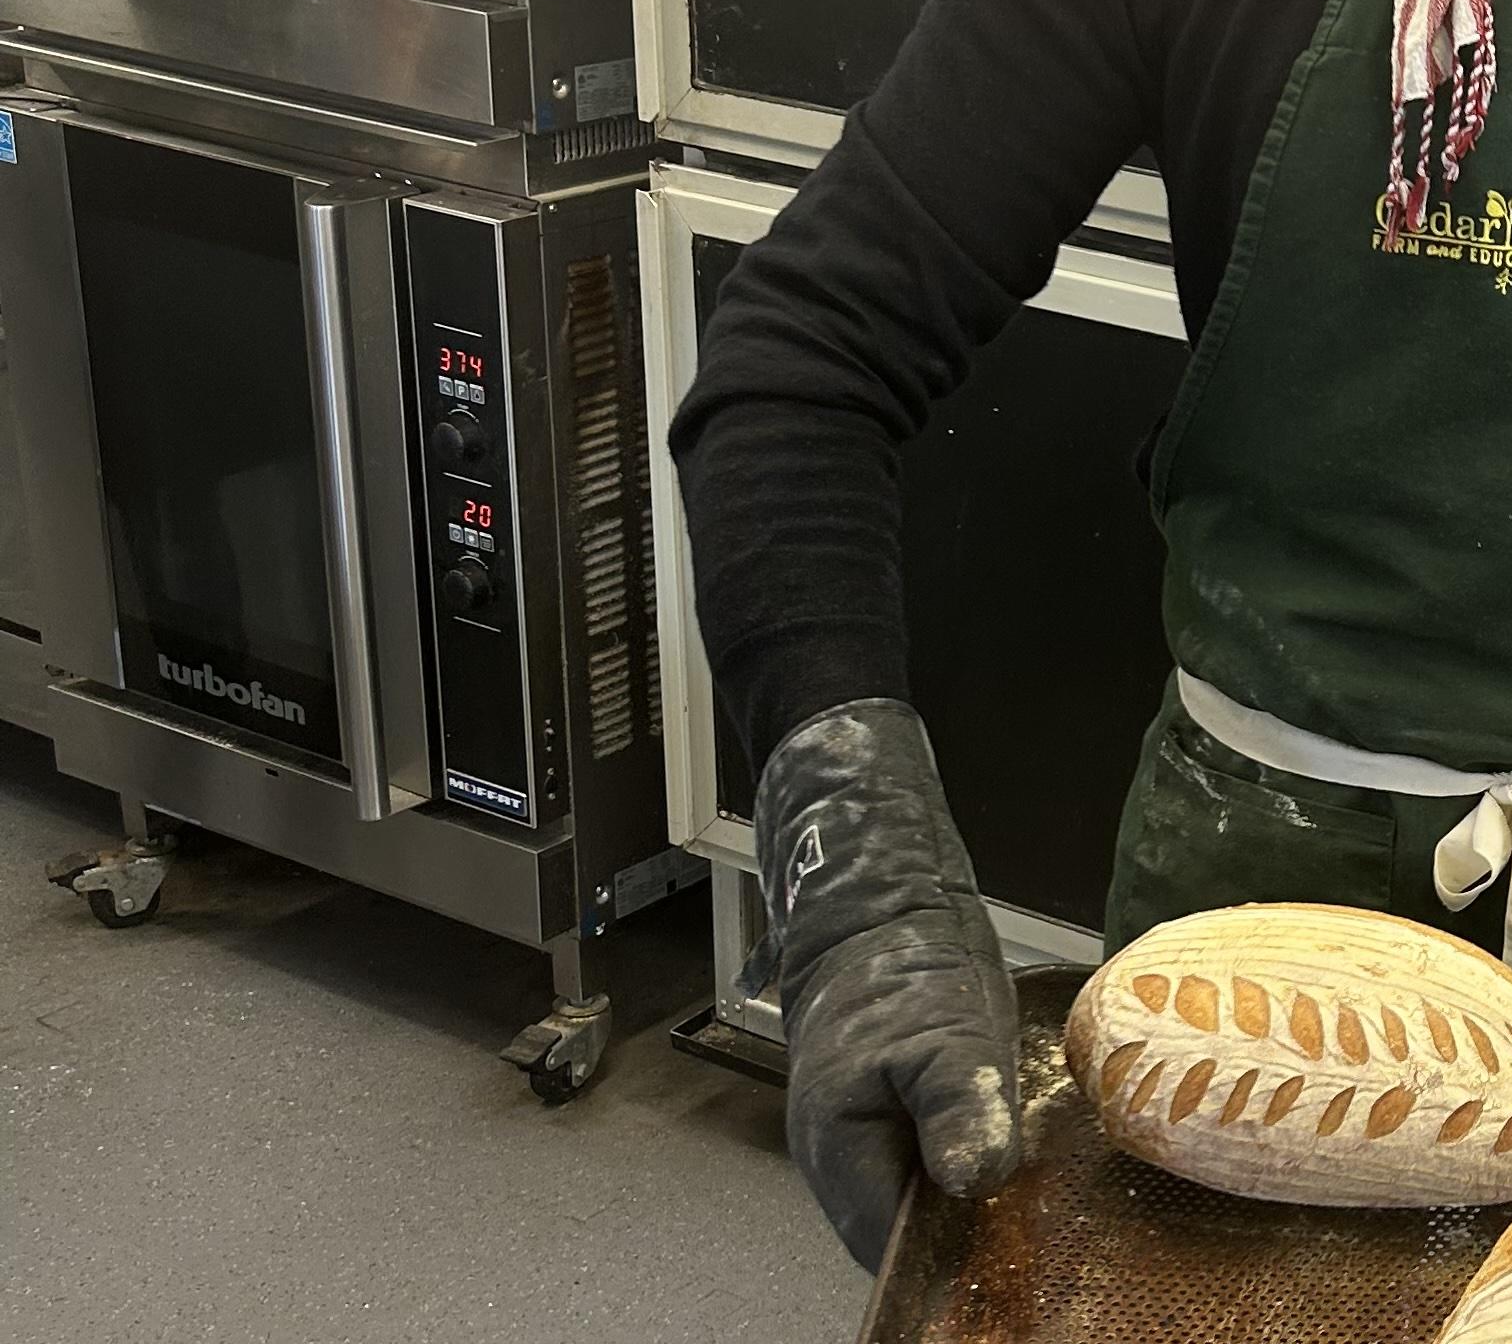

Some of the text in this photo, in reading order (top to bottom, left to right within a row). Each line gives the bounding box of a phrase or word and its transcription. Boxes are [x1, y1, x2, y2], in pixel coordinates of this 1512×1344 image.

[440, 348, 482, 378] 374
[464, 500, 491, 527] 20
[157, 653, 306, 726] turbofan
[448, 777, 522, 809] MOFFAT
